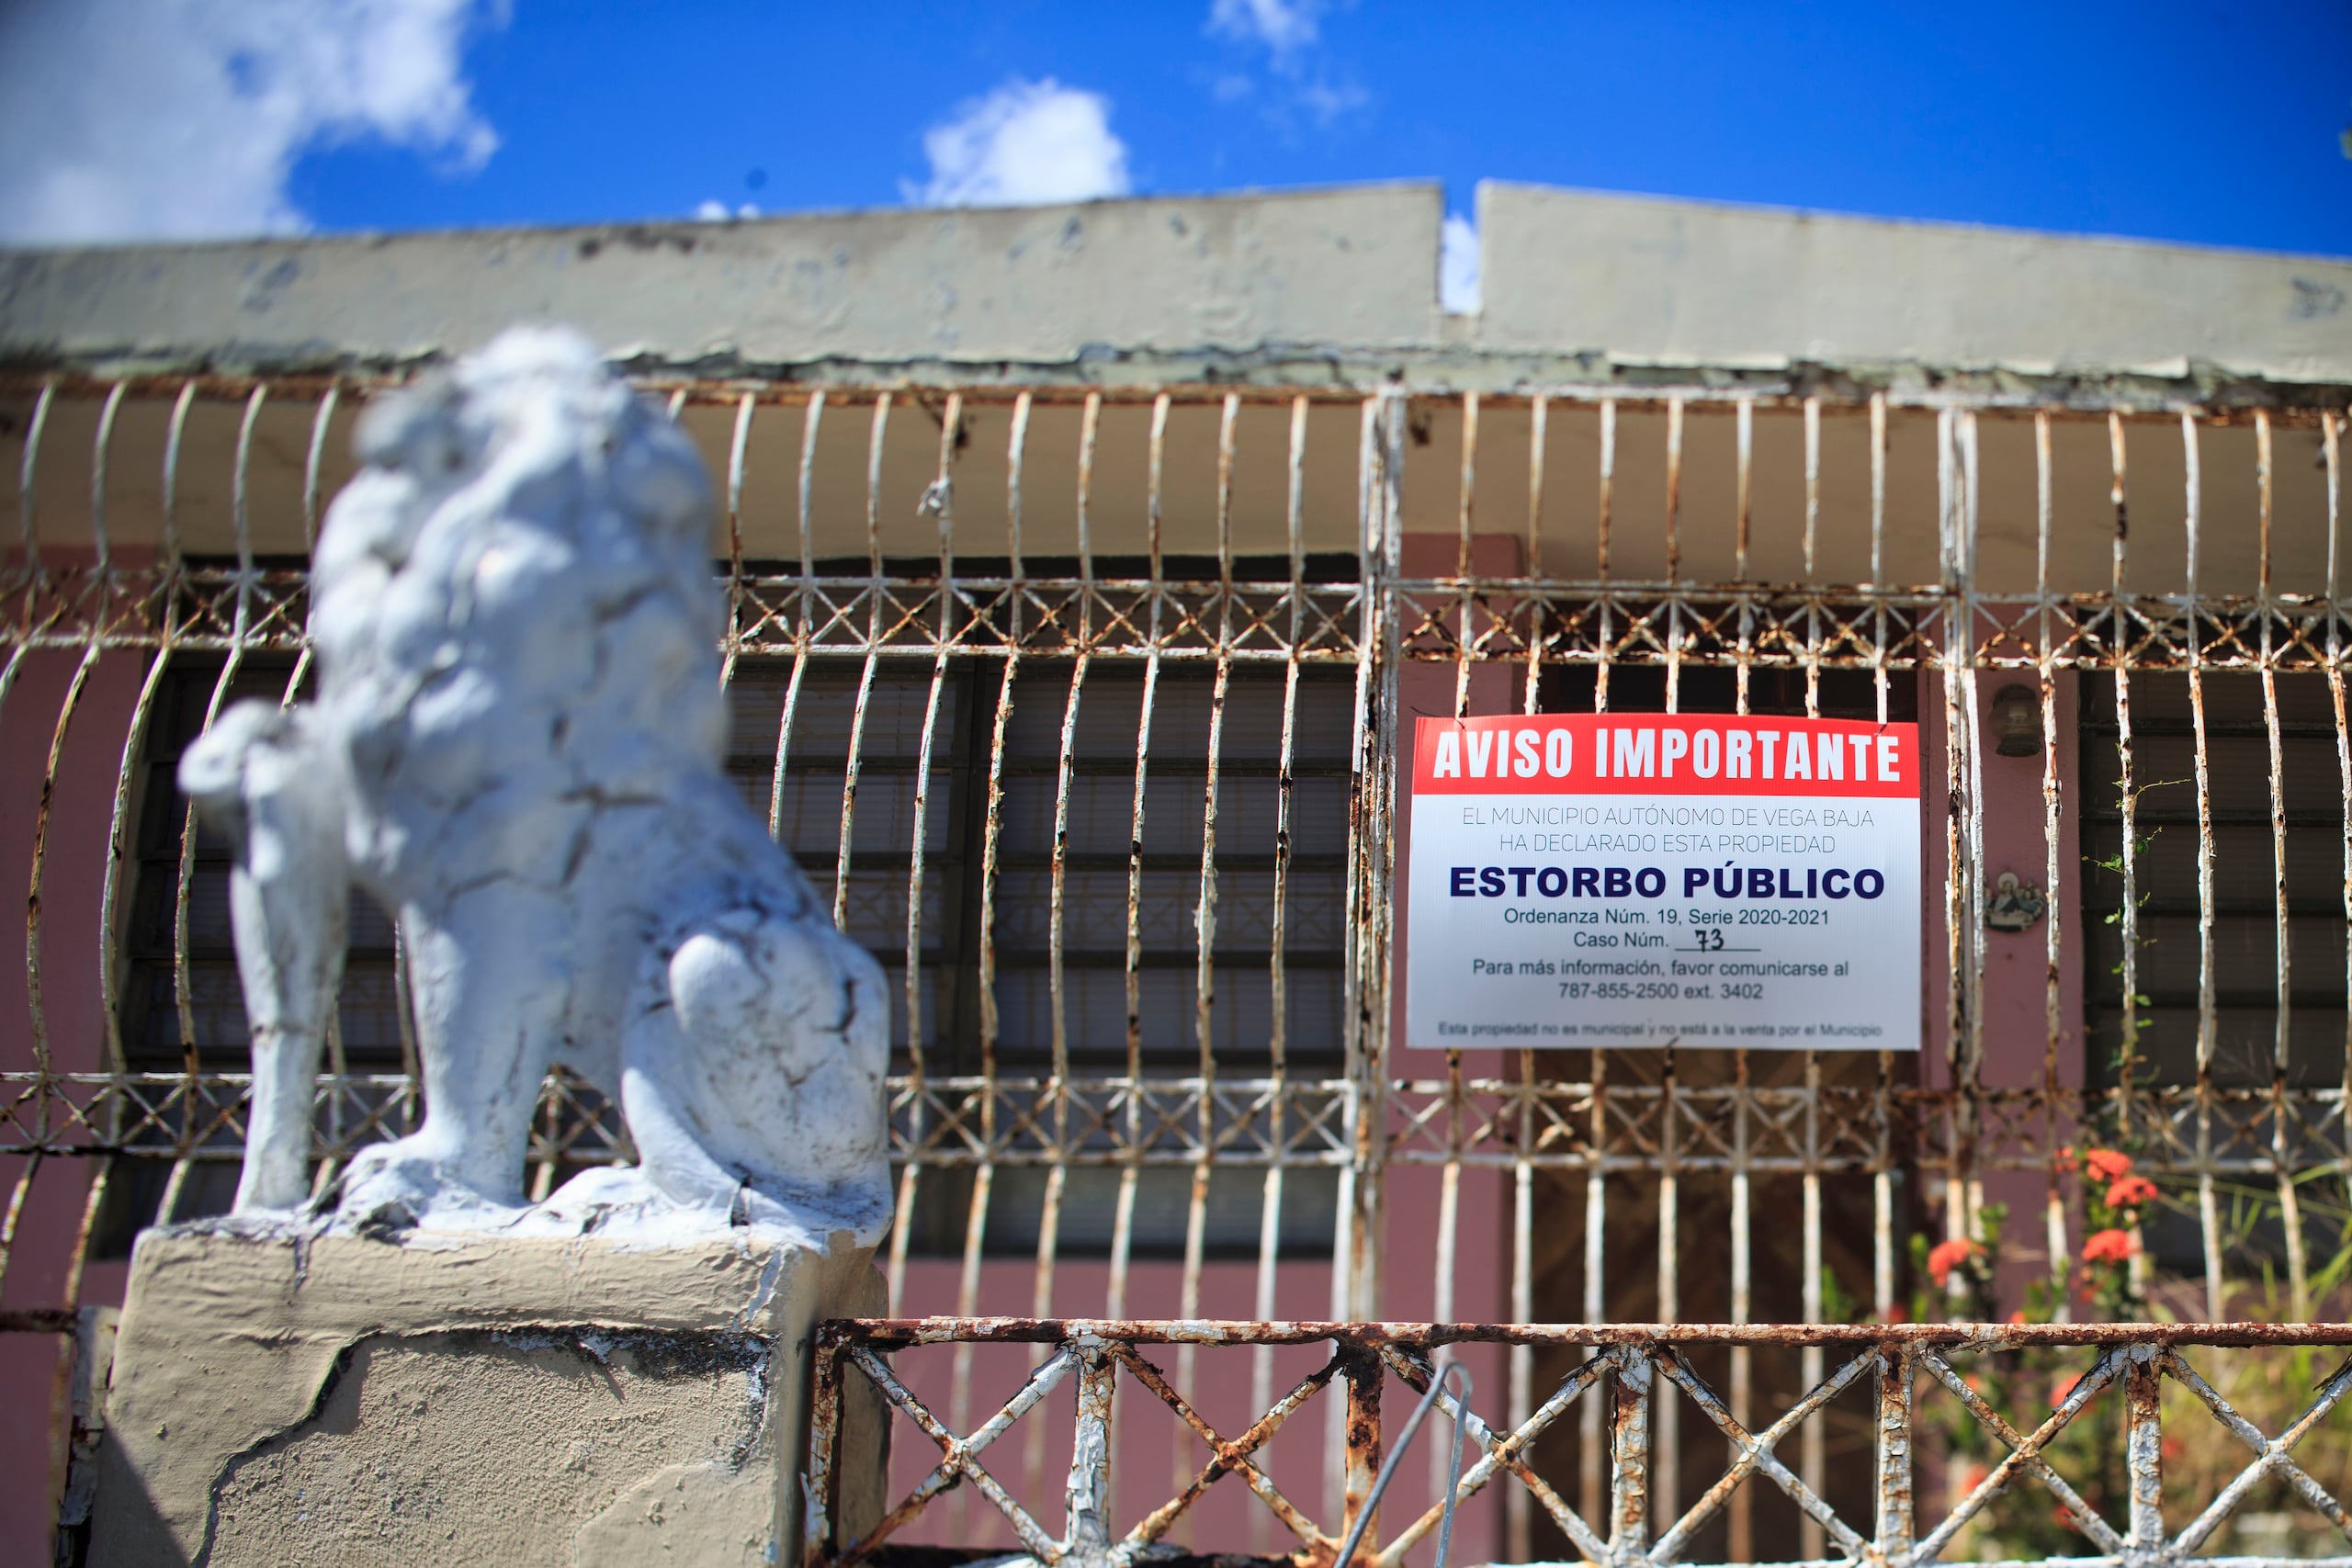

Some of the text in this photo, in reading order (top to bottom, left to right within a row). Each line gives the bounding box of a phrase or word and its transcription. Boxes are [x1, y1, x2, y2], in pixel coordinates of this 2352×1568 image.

[1433, 728, 1900, 782] AVISO IMPORTANTE
[1464, 803, 1874, 827] EL MUNICIPIO AUTÓNOMO DE VEGA BAJA
[1500, 834, 1836, 852] HA DECLARADO ESTA PROPIEDAD
[1450, 861, 1884, 899] ESTORBO PÚBLICO
[1504, 908, 1828, 926] Ordenanza Núm. 19, Serie 2020-2021
[1574, 928, 1725, 953] Caso Núm. 73
[1473, 959, 1849, 976] Para más información, favor comunicarse al
[1559, 983, 1763, 999] 787-855-2500 ext. 3402
[1439, 1021, 1883, 1040] Esta propiedad no es municipal y no está a la venta por el Municipio
